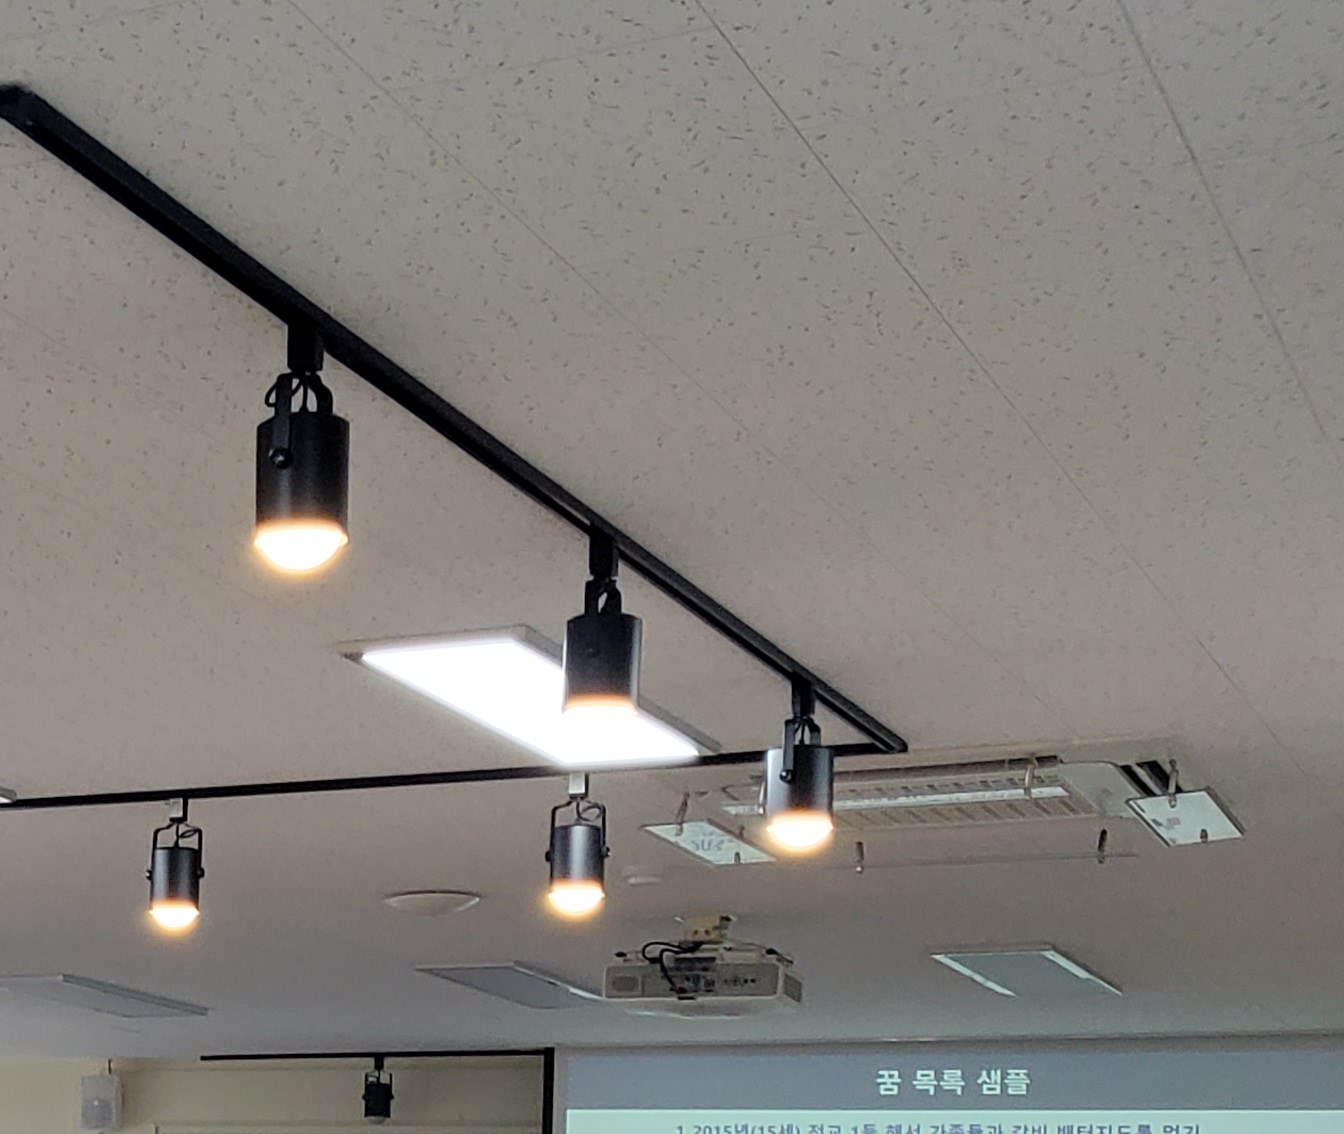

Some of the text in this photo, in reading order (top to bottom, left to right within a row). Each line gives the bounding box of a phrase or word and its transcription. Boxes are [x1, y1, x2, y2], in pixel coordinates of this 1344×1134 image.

[876, 1068, 1031, 1096] 꿈 목록 샘플
